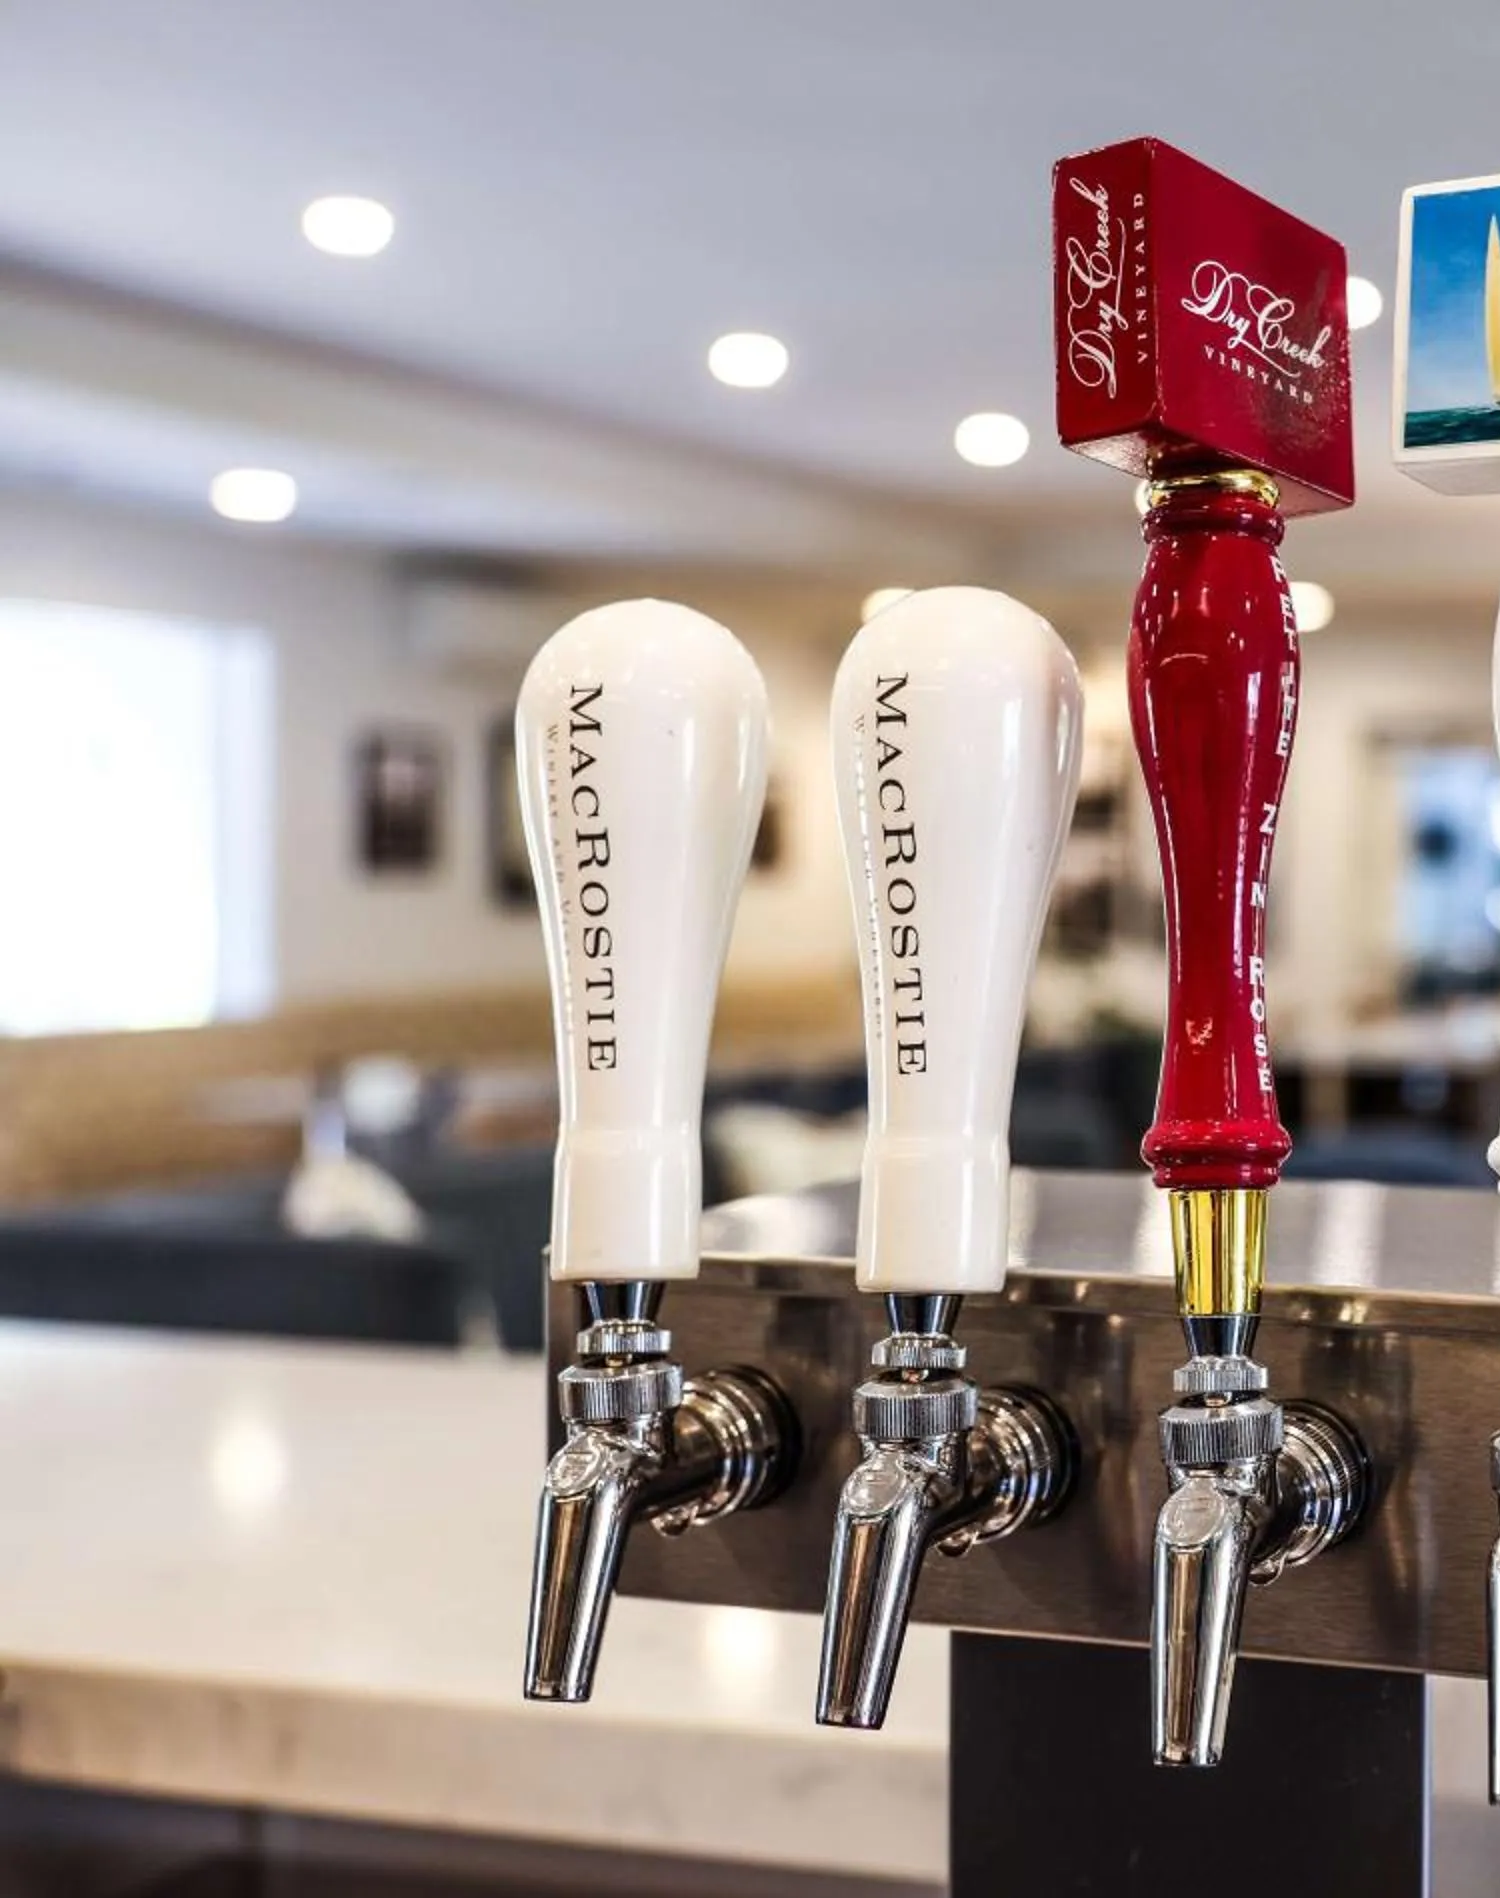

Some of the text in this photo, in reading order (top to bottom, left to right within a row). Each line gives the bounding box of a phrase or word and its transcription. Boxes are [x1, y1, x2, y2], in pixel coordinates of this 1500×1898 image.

[1066, 178, 1129, 399] Dry Creek
[1132, 192, 1148, 364] VINEYARD
[1181, 260, 1331, 370] Dry Creek
[1204, 345, 1314, 404] VINEYARD
